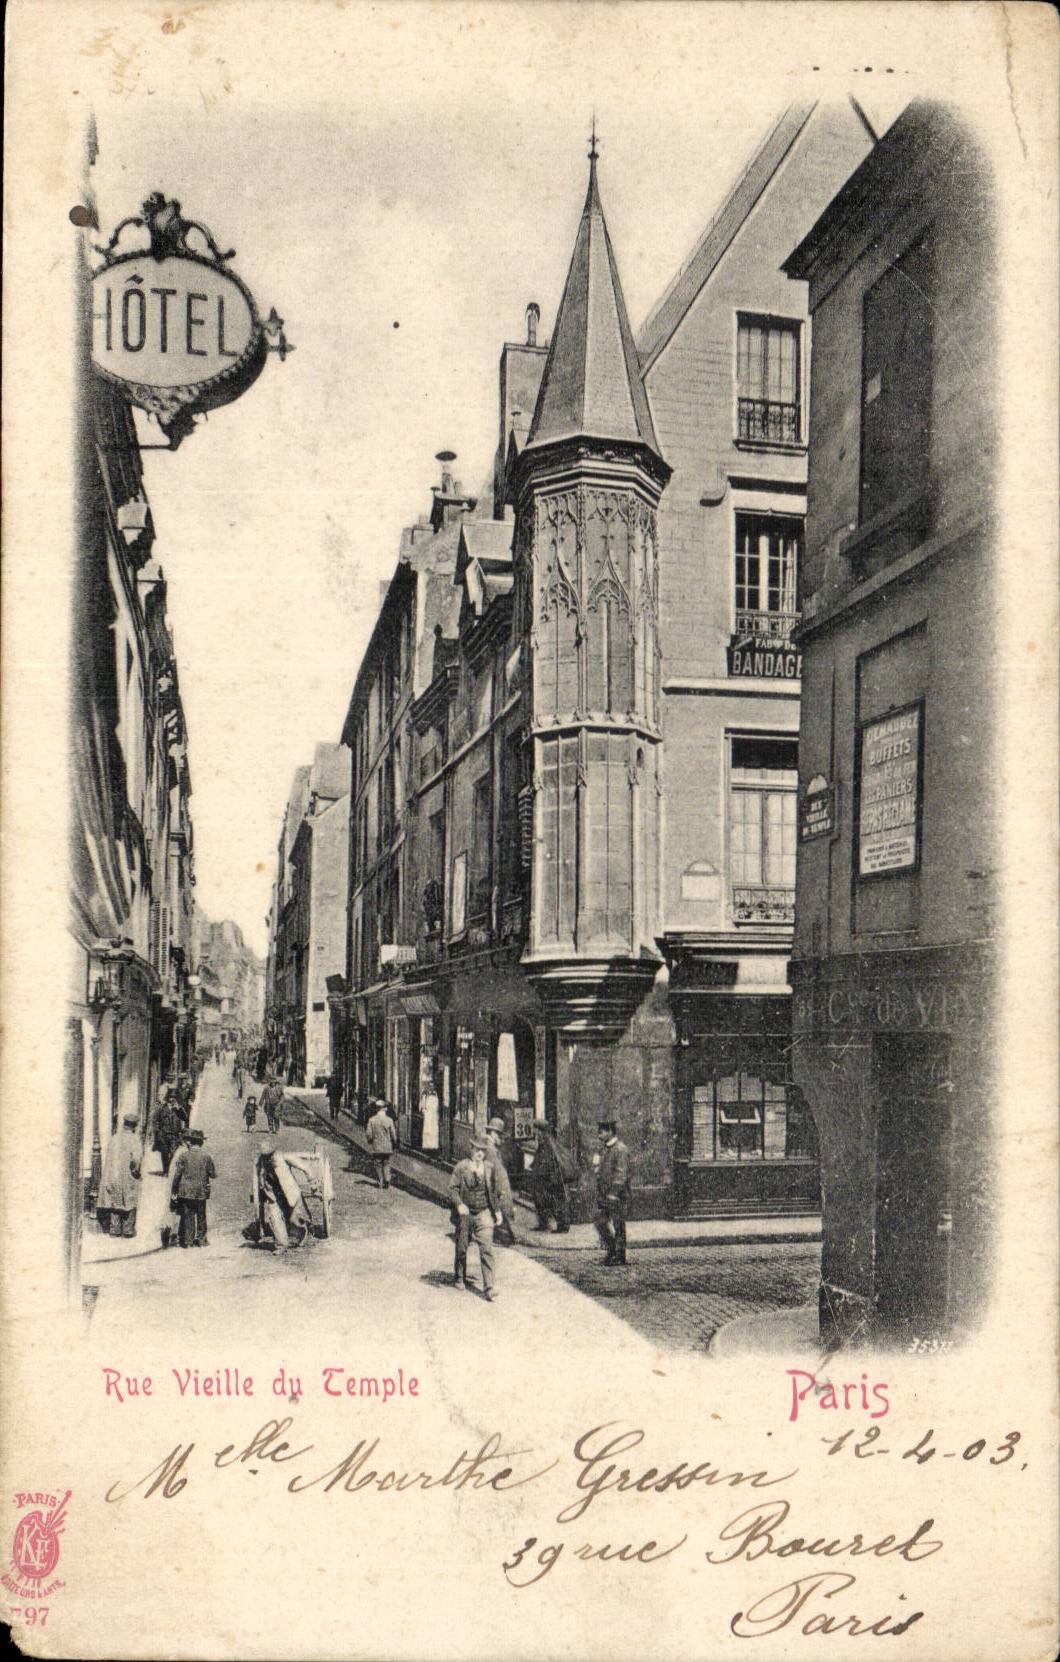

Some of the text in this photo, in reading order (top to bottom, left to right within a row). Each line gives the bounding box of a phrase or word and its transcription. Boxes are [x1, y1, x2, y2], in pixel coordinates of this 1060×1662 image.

[287, 1432, 558, 1492] Marthe
[575, 1533, 688, 1563] rue
[730, 1572, 925, 1638] Paris
